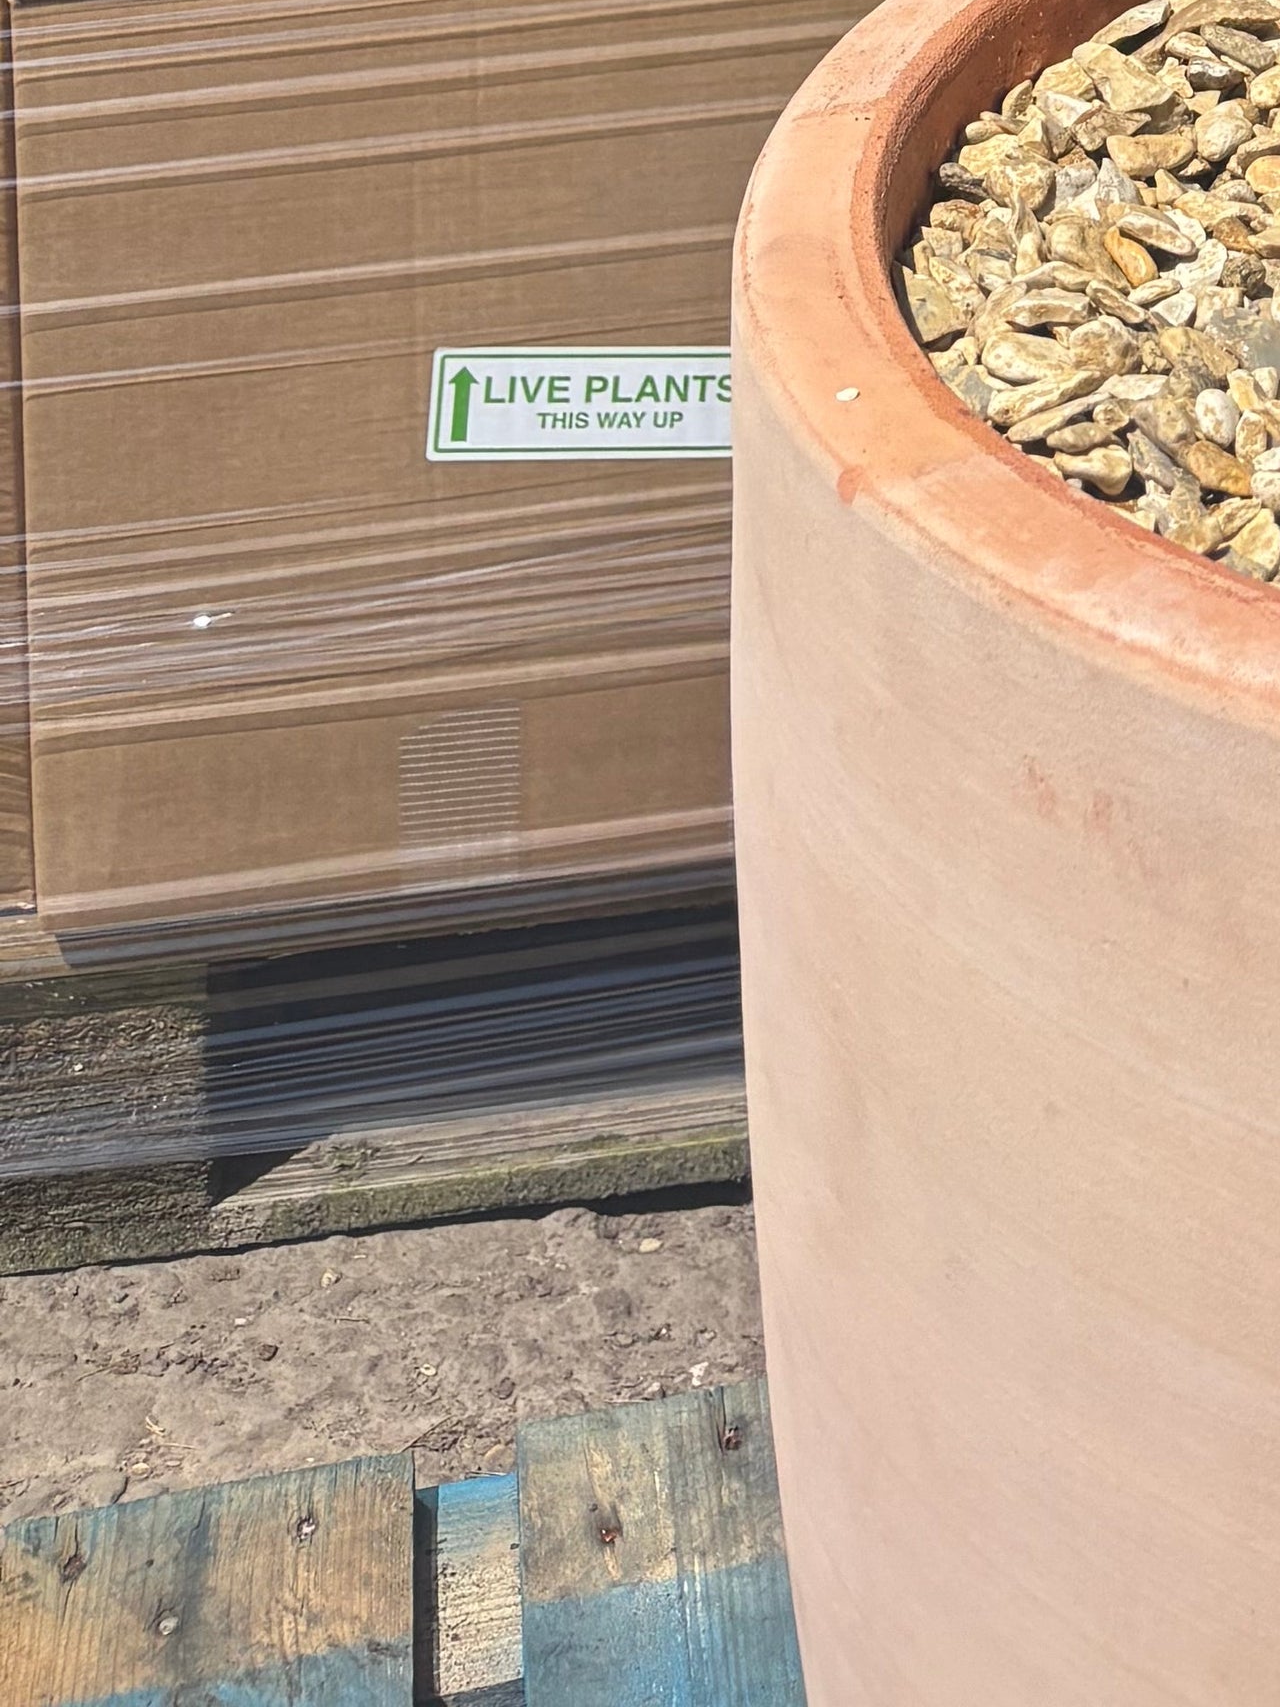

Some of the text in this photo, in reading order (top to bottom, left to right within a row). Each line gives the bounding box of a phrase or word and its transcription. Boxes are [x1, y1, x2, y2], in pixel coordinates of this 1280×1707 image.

[483, 375, 572, 404] LIVE
[536, 410, 684, 430] THIS WAY UP
